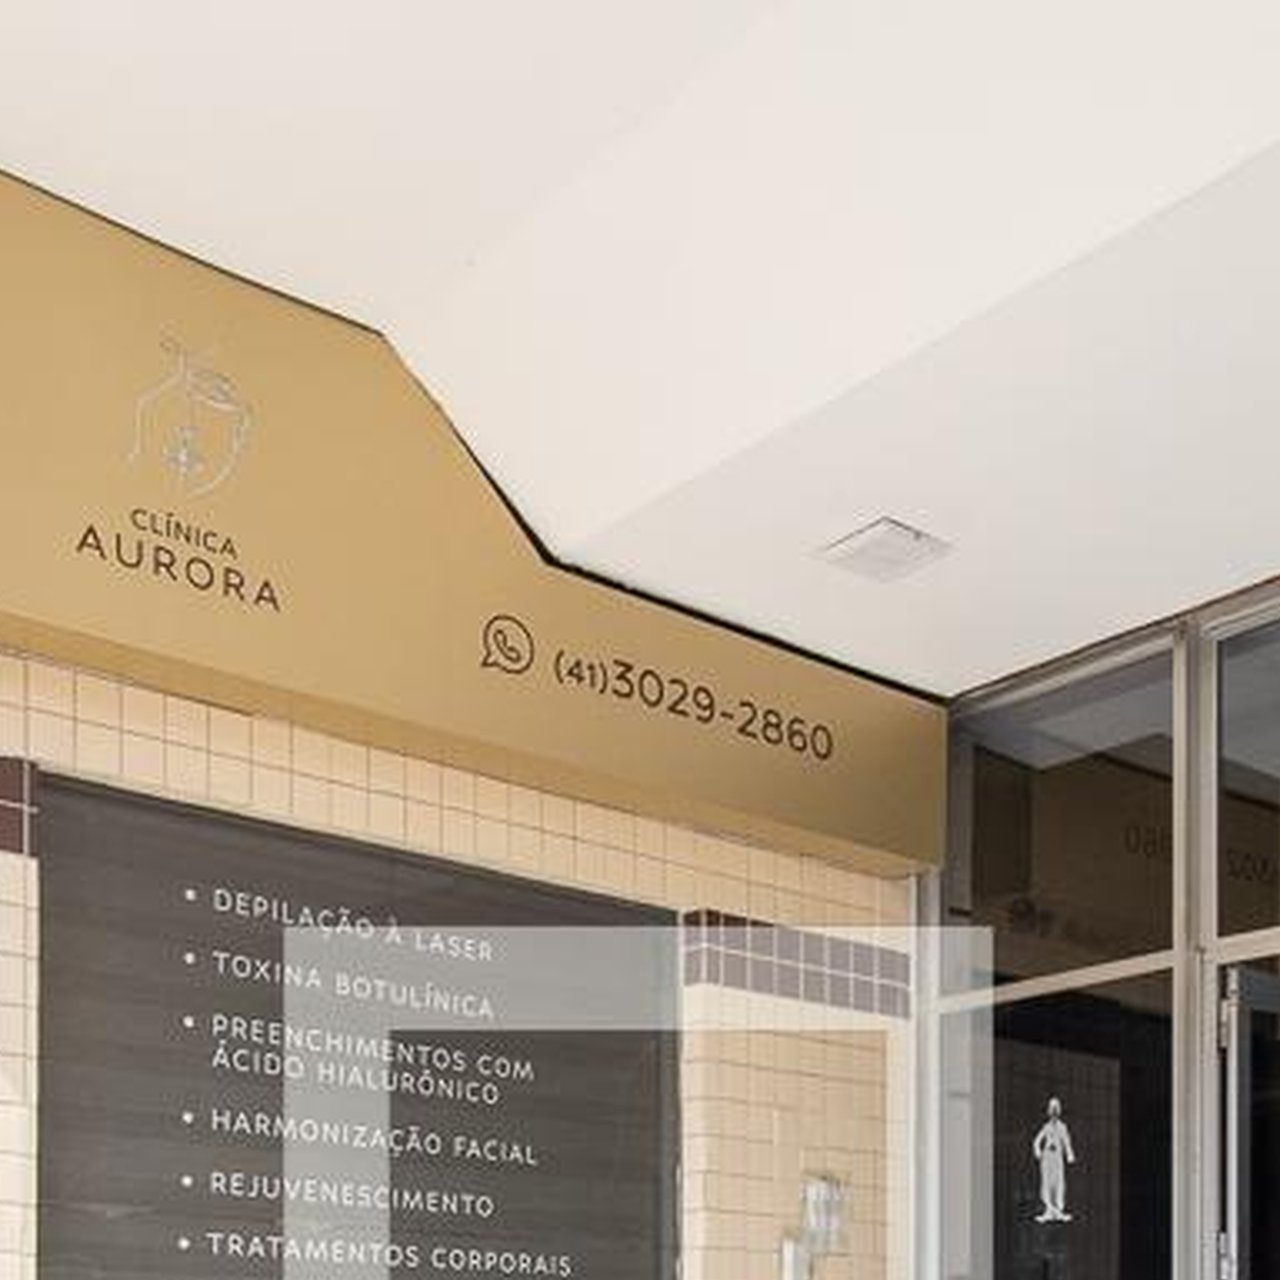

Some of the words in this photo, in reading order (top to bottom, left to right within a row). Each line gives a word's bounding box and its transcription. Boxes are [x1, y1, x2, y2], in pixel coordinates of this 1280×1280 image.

[131, 508, 238, 559] CLÍNICA
[77, 524, 282, 612] AURORA
[213, 889, 376, 941] DEPILAÇÃO
[415, 931, 494, 962] LASER
[213, 951, 322, 988] TOXINA
[335, 972, 495, 1019] BOTULÍNICA
[212, 1014, 466, 1073] PREENCHIMENTOS
[477, 1055, 535, 1081] COM
[212, 1042, 305, 1079] ÁCIDO
[319, 1063, 499, 1105] HIALURÔNICO
[212, 1109, 442, 1158] HARMONIZAÇÃO
[454, 1136, 538, 1166] FACIAL
[211, 1173, 494, 1218] REJUVENESCIMENTO
[207, 1233, 418, 1268] TRATAMENTOS
[431, 1248, 572, 1278] CORPORAIS
